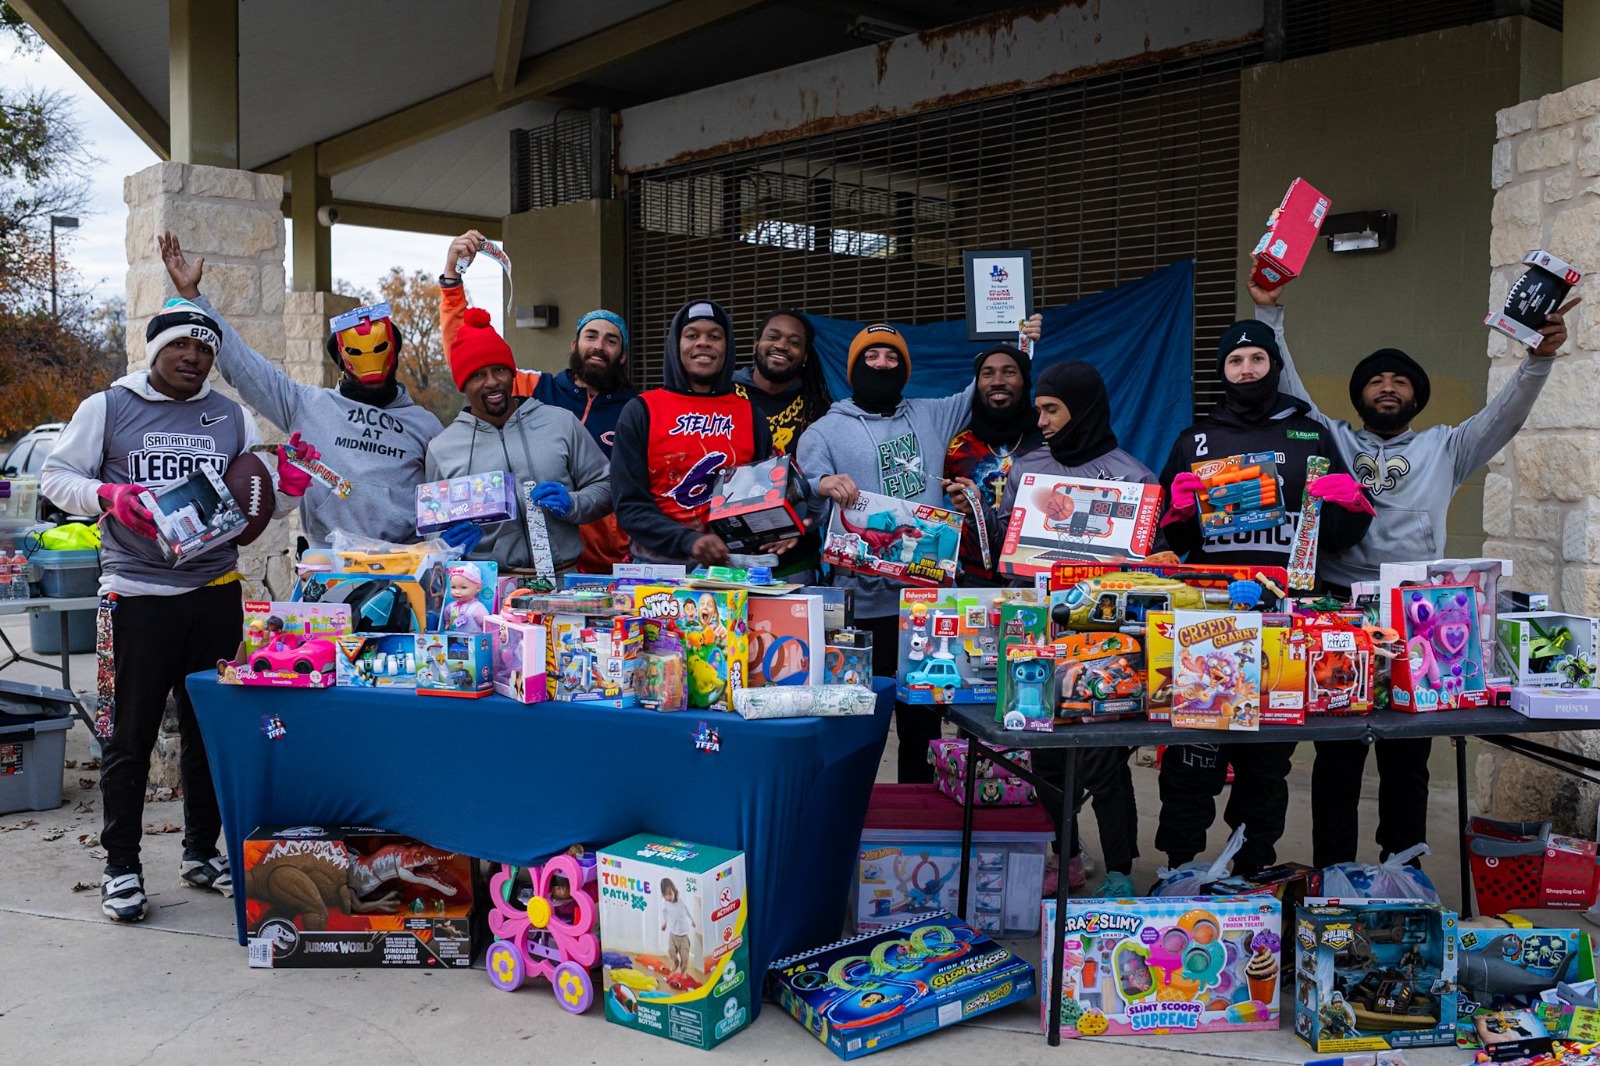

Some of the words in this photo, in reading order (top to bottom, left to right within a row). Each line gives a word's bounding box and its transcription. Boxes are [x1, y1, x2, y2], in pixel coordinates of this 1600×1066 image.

[190, 327, 220, 357] SPUR
[347, 408, 404, 433] TACOS
[669, 411, 735, 440] STELITA
[362, 428, 382, 440] AT
[147, 436, 168, 447] SAN
[171, 436, 212, 450] ANTONIO
[334, 437, 406, 460] MIDNIIGHT
[878, 432, 916, 468] FLY
[1194, 433, 1209, 456] 2
[1195, 463, 1225, 477] NERF
[661, 451, 727, 509] 6
[917, 511, 929, 519] ME
[919, 506, 931, 514] TRY
[1140, 505, 1149, 524] HOOP
[1136, 526, 1144, 539] TOY
[1139, 505, 1153, 547] BASKETBALL
[1292, 512, 1315, 569] CHAMPIONS
[920, 559, 936, 567] DINO
[906, 563, 945, 581] ACTION
[644, 592, 671, 604] HUNGRY
[1179, 616, 1236, 647] GREEDY
[1213, 628, 1258, 648] GRANNY
[236, 667, 258, 680] Barbie
[1393, 690, 1410, 702] KID
[1415, 691, 1437, 705] KID
[1555, 704, 1588, 713] PRISM
[267, 727, 287, 739] TFFA
[695, 740, 720, 752] TFFA
[647, 843, 699, 858] TURTLE
[657, 852, 687, 861] PATH
[602, 872, 651, 894] TURTLE
[686, 883, 697, 892] 3+
[603, 887, 629, 901] PATH
[716, 901, 737, 918] ACTIVITY
[1324, 929, 1352, 940] SOLDIER
[303, 940, 339, 953] JURASSIC
[339, 940, 374, 953] WORLD
[783, 964, 807, 977] 74
[933, 968, 967, 987] GLOW
[967, 949, 1009, 973] TRACKS
[938, 963, 958, 973] HIGH
[960, 954, 985, 965] SPEED
[720, 976, 740, 993] BALANCE
[637, 1005, 661, 1016] NON-SLIP
[1162, 1003, 1201, 1013] SCOOPS
[638, 1011, 657, 1022] RUBBER
[1131, 1013, 1199, 1028] SUPREME
[638, 1018, 662, 1030] BOTTOMS
